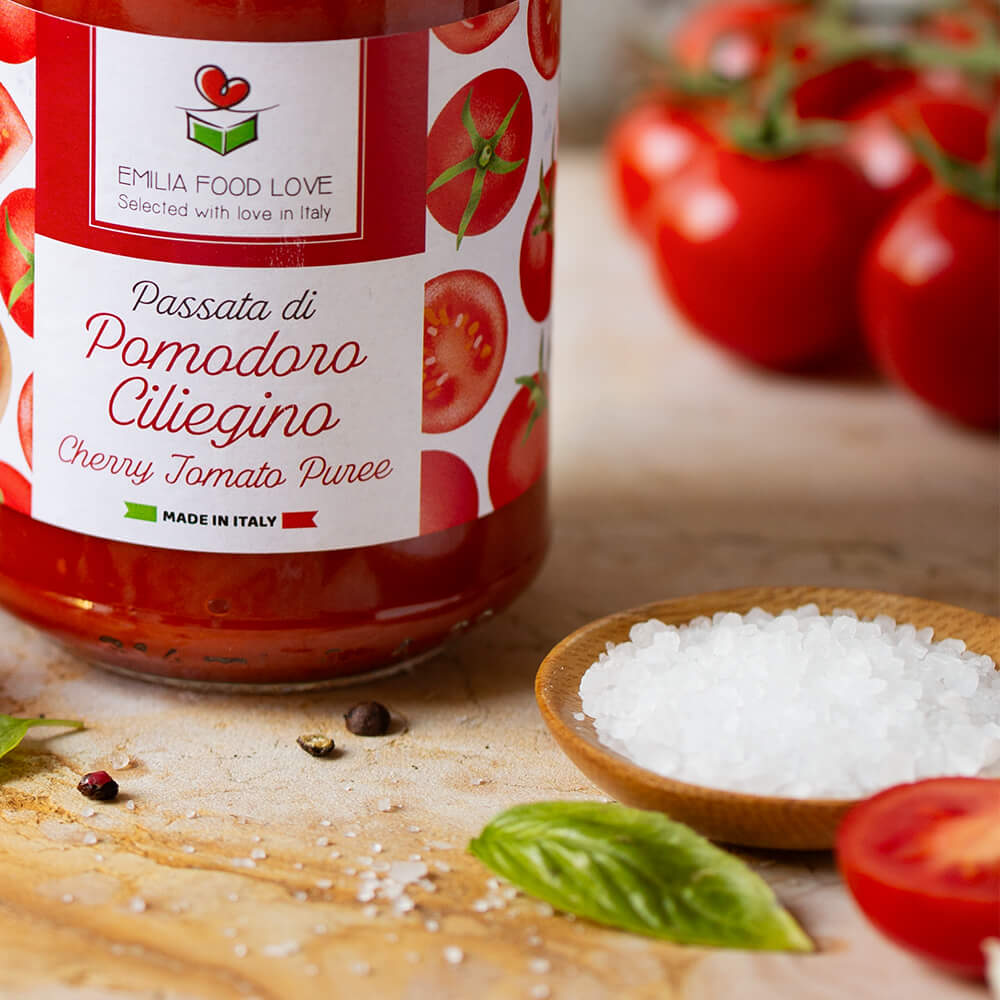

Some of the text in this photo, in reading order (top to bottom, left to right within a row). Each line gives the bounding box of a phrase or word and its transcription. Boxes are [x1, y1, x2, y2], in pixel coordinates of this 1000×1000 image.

[118, 166, 333, 197] EMILIA FOOD LOVE
[118, 194, 332, 222] Selected with love in Italy
[131, 279, 317, 321] Passata di
[84, 312, 369, 378] Pomodoro
[107, 376, 341, 450] Ciliegino
[57, 434, 395, 489] Cherry Tomato Puree
[162, 510, 278, 529] MADE IN ITALY
